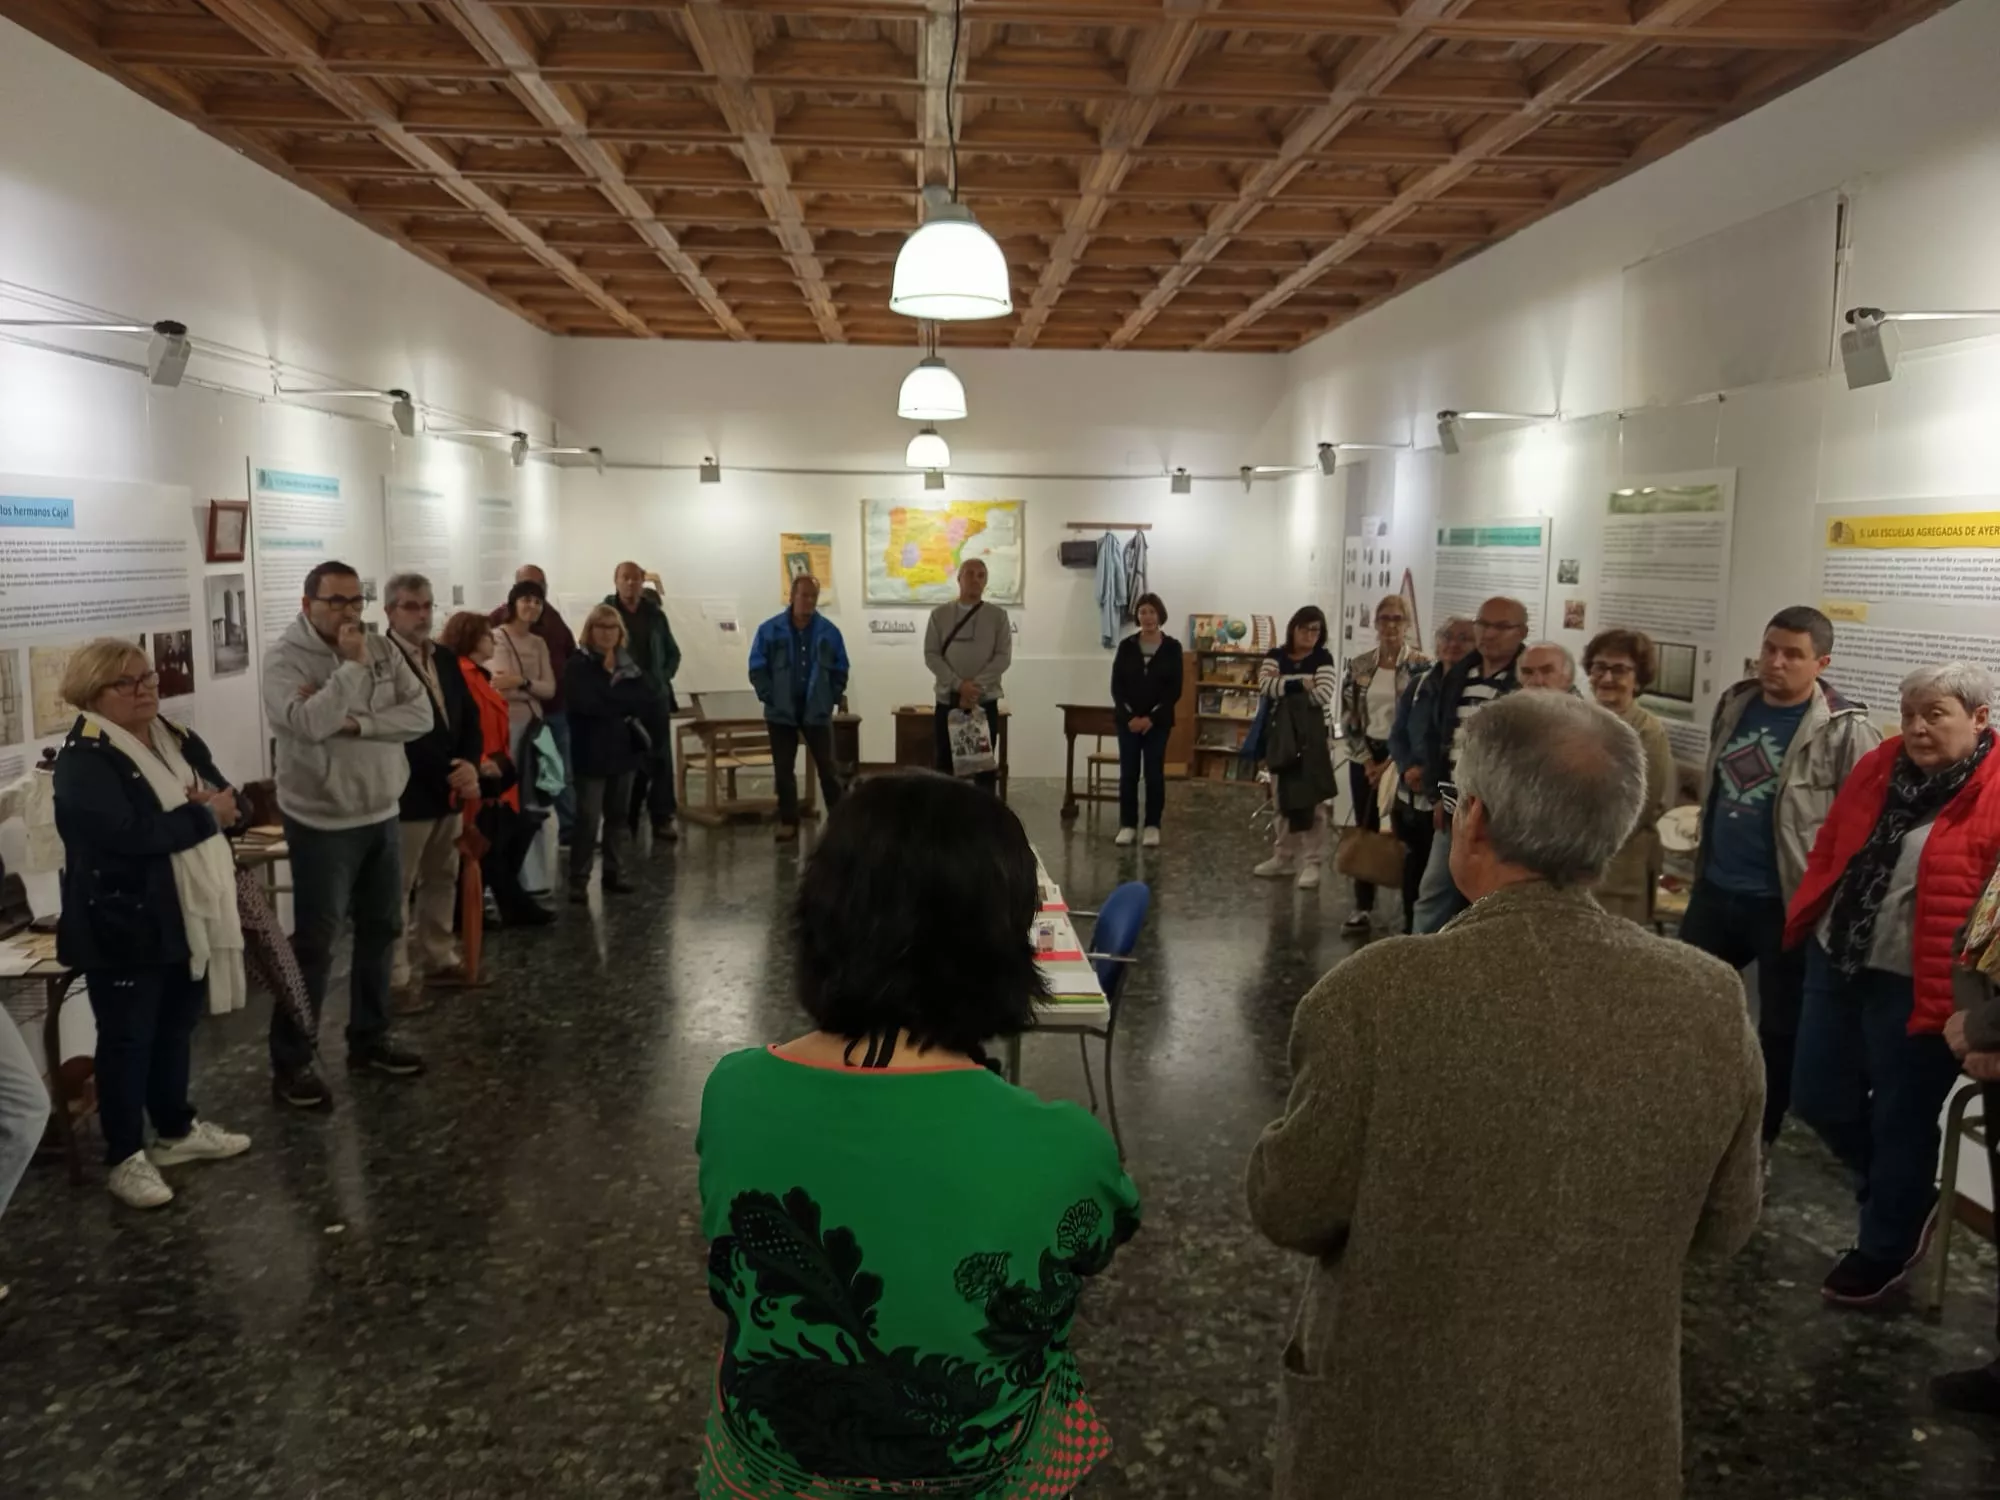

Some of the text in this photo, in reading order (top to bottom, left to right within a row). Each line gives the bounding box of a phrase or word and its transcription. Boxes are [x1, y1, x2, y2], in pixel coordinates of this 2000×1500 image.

[13, 504, 50, 518] hermanos
[52, 505, 69, 521] Cajal
[1867, 527, 1879, 538] LAS
[1880, 526, 1914, 538] ESCUELAS
[1916, 526, 1963, 537] AGREGADAS
[1965, 525, 1976, 536] DE
